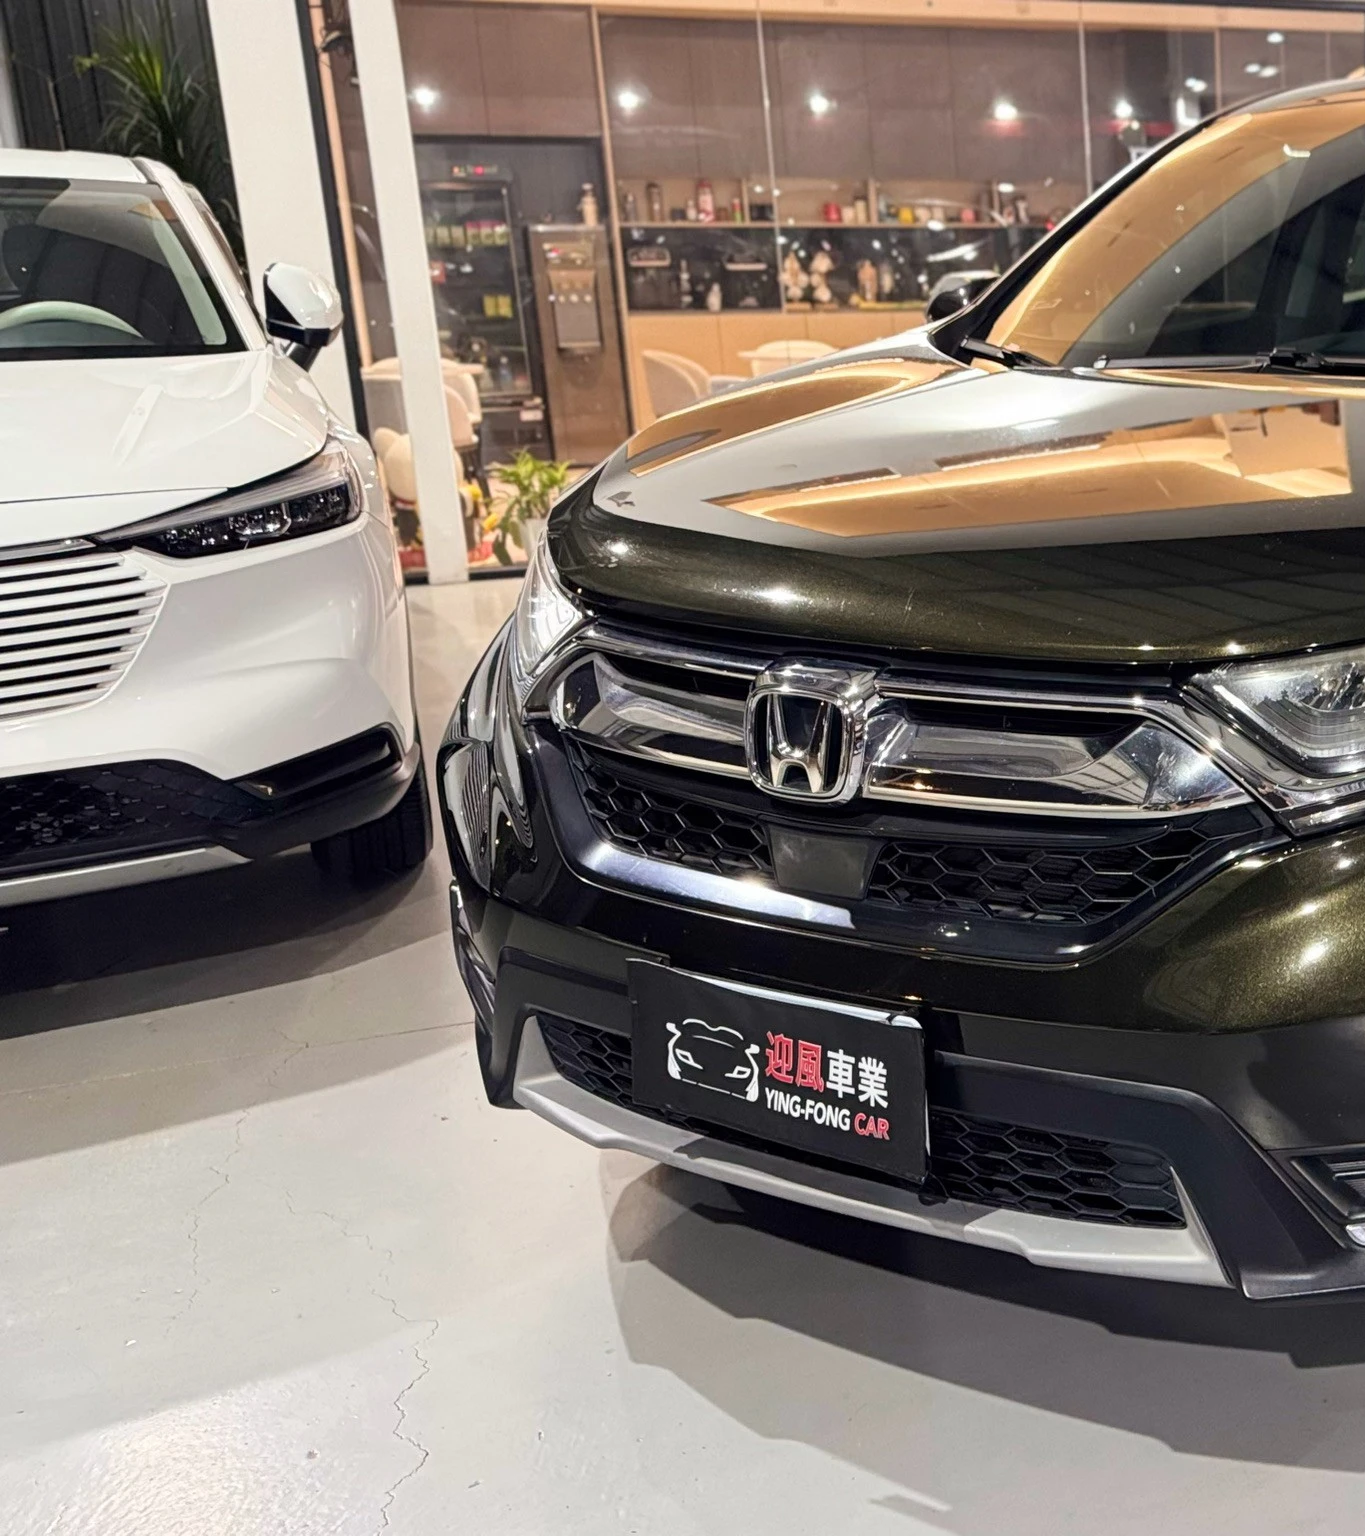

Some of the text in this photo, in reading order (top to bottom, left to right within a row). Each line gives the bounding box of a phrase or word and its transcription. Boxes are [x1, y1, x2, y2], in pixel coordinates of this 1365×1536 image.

[765, 1031, 889, 1108] 迎風車業
[765, 1087, 890, 1140] YING-FONG CAR
